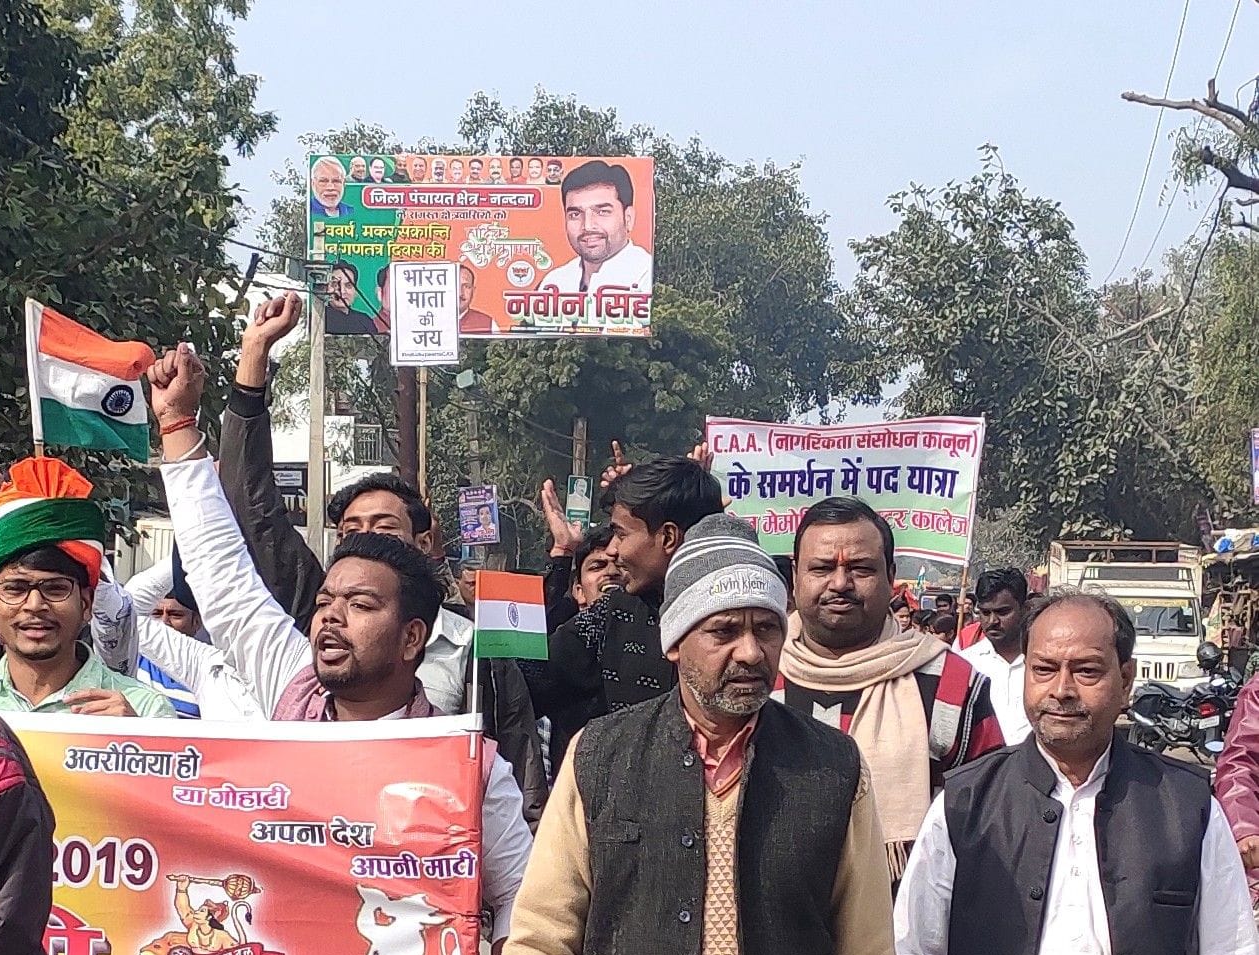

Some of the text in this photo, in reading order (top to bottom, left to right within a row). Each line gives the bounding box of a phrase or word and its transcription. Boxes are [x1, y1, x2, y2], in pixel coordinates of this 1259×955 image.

[370, 188, 404, 205] जिला
[409, 190, 455, 205] पंचायत
[362, 224, 396, 238] मकर
[387, 240, 424, 256] दिवस
[425, 241, 446, 258] की
[406, 291, 446, 308] माता
[503, 284, 652, 319] नवीन सिंह
[418, 311, 434, 326] की
[411, 330, 443, 347] जय
[713, 432, 762, 453] C.A.A.
[727, 457, 959, 499] के समर्थन में पद यात्रा
[65, 744, 200, 778] अतरौलिया हो
[174, 784, 289, 809] या गोहाटी
[252, 818, 374, 847] अपना देश
[51, 840, 154, 886] 019
[352, 850, 476, 877] अपनी माटी
